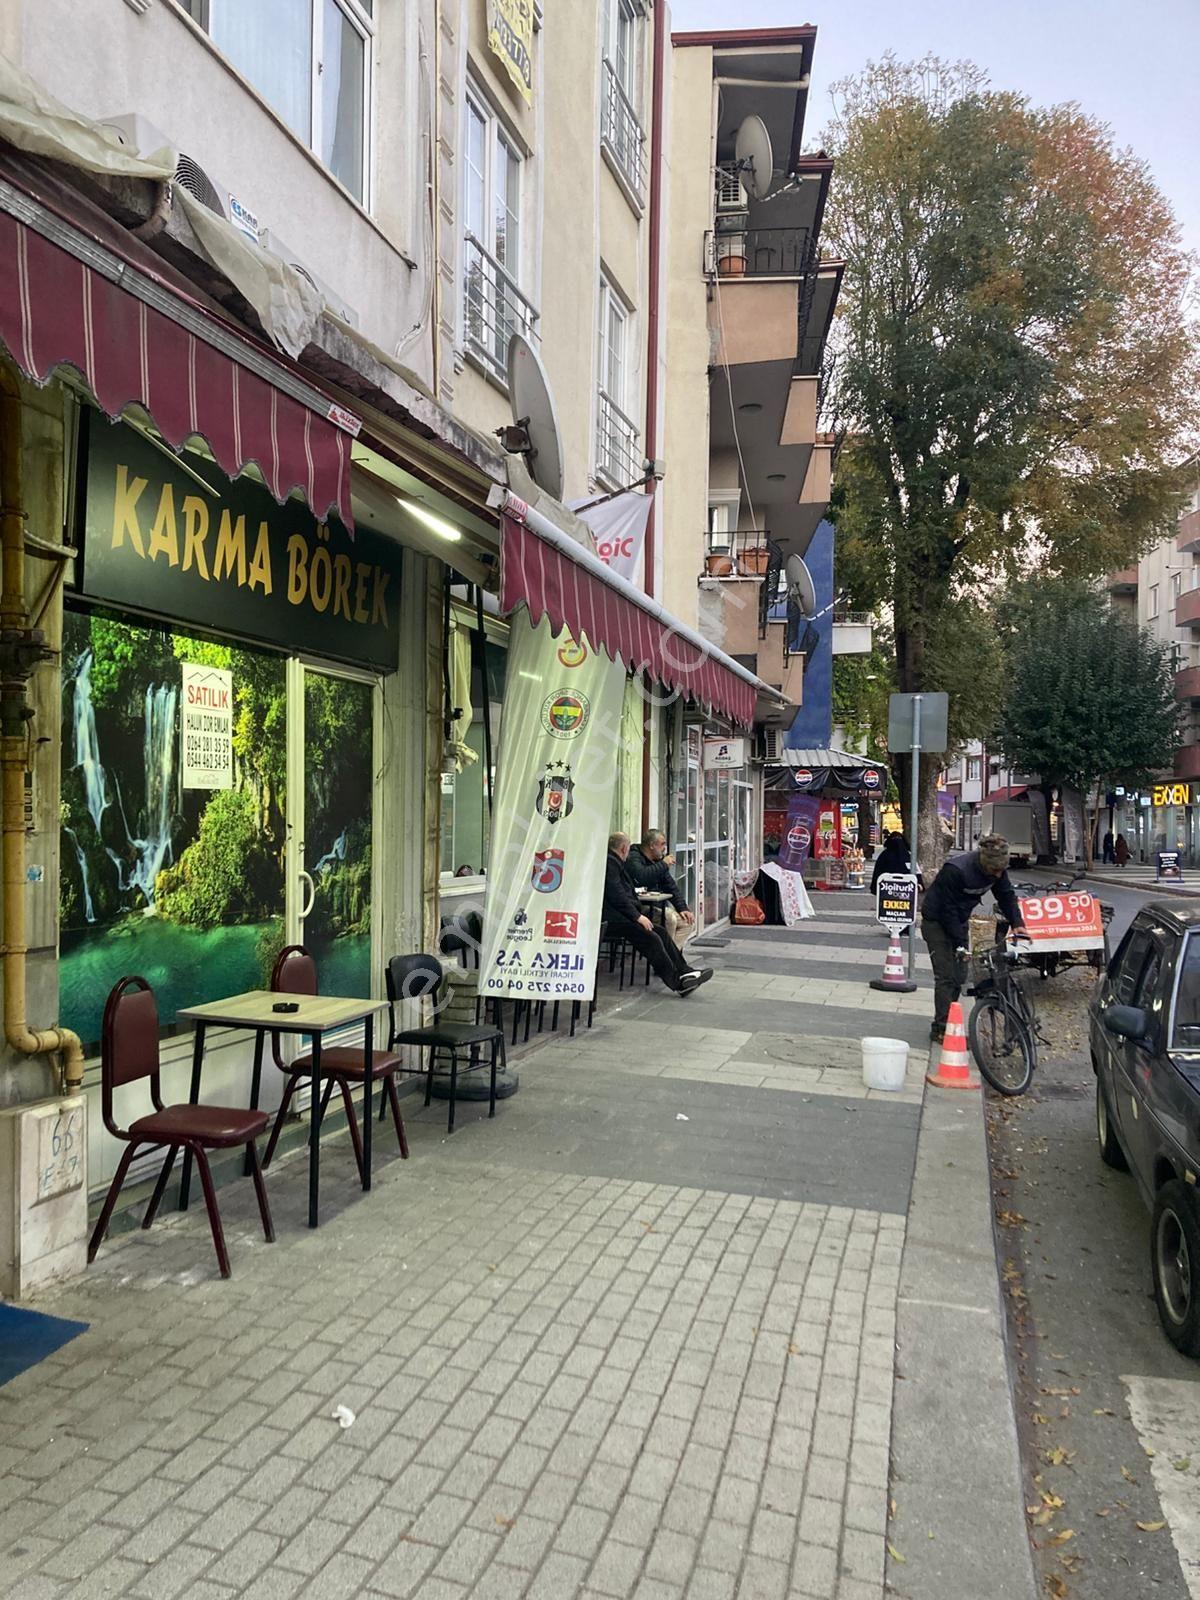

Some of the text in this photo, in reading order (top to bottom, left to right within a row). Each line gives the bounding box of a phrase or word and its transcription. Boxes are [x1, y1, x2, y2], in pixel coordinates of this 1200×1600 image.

[111, 464, 391, 630] KARMA BÖREK
[187, 684, 229, 709] SATILIK
[186, 735, 201, 752] 0264
[186, 751, 201, 768] 0544
[1153, 784, 1189, 806] EXXEN
[788, 834, 809, 843] PEPSI
